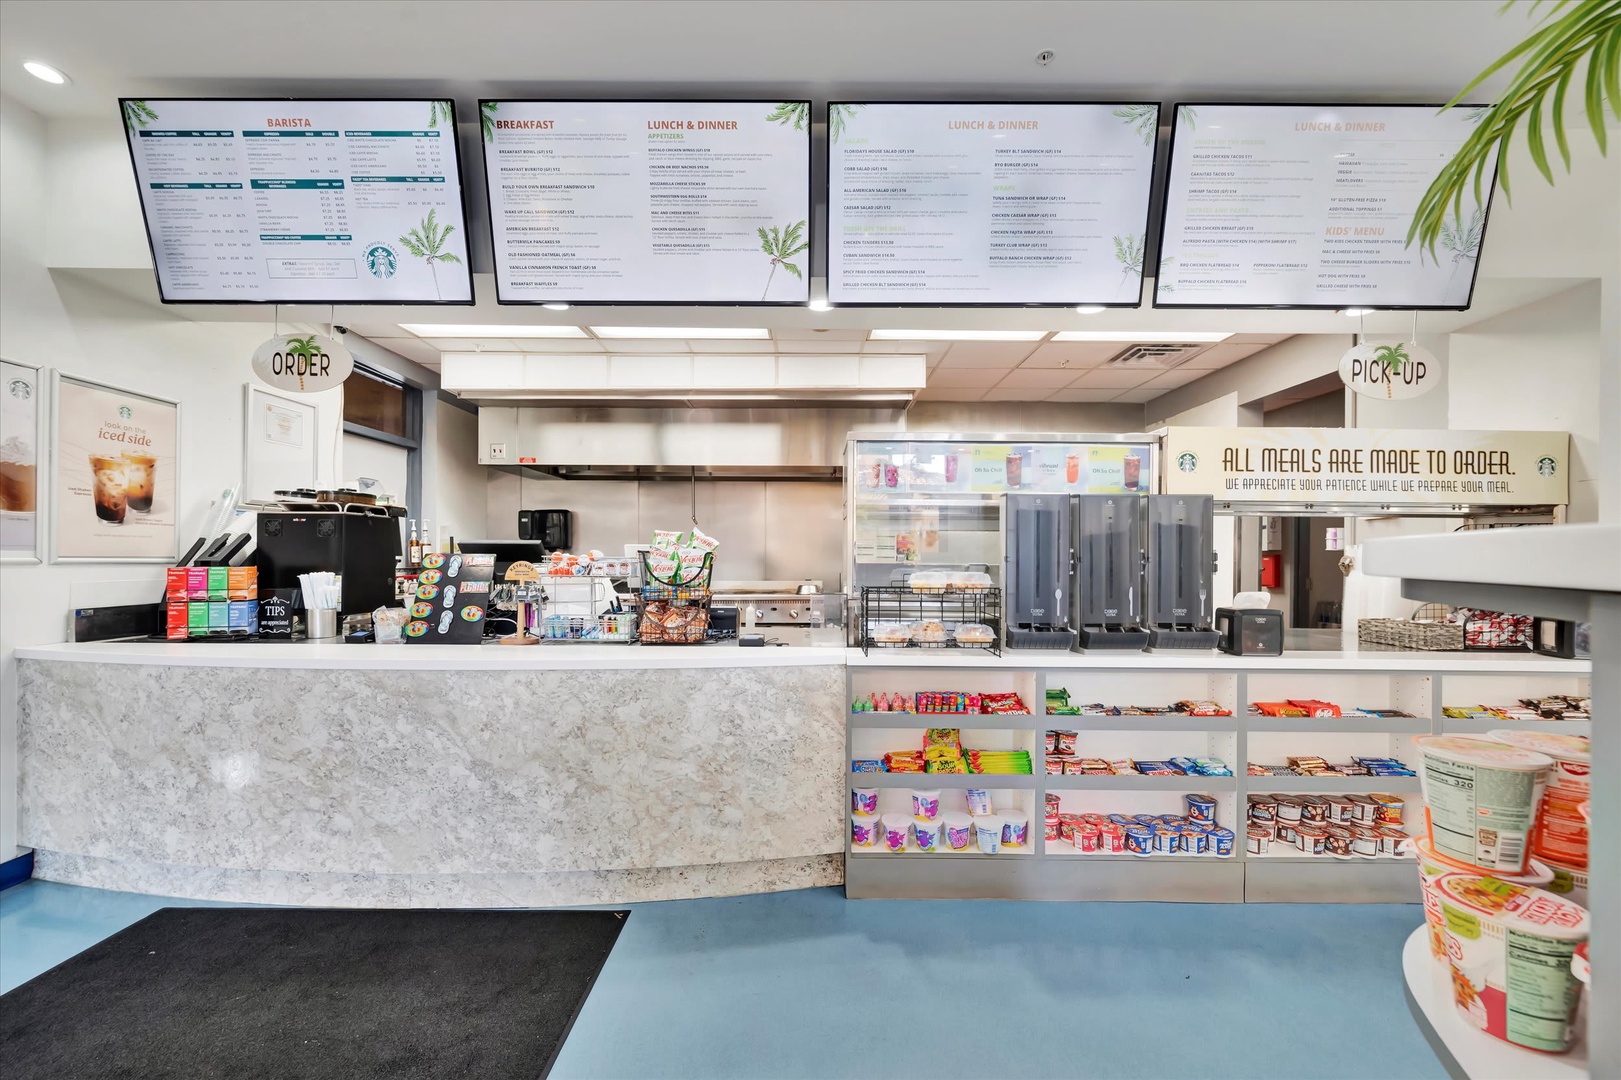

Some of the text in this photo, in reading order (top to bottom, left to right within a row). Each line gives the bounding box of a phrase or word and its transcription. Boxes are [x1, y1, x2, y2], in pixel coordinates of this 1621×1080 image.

[267, 118, 311, 127] BARISTA
[496, 120, 554, 129] BREAKFAST
[648, 121, 737, 130] LUNCH & DINNER
[948, 121, 1038, 130] LUNCH & DINNER
[1294, 122, 1386, 131] LUNCH & DINNER
[1326, 227, 1385, 236] KIDS' MENU
[273, 352, 330, 376] ORDER
[1352, 359, 1426, 385] PICK-UP
[104, 421, 121, 429] look
[134, 426, 146, 434] the
[98, 428, 152, 446] iced side
[1222, 448, 1516, 475] ALL MEALS ARE MADE TO ORDER.
[1226, 478, 1514, 493] WE APPRECIATE YOUR PATIENCE WHILE WE PREPARE YOUR MEAL.
[510, 563, 534, 572] KEYRINGS
[265, 605, 285, 616] TIPS
[1454, 779, 1474, 788] 320
